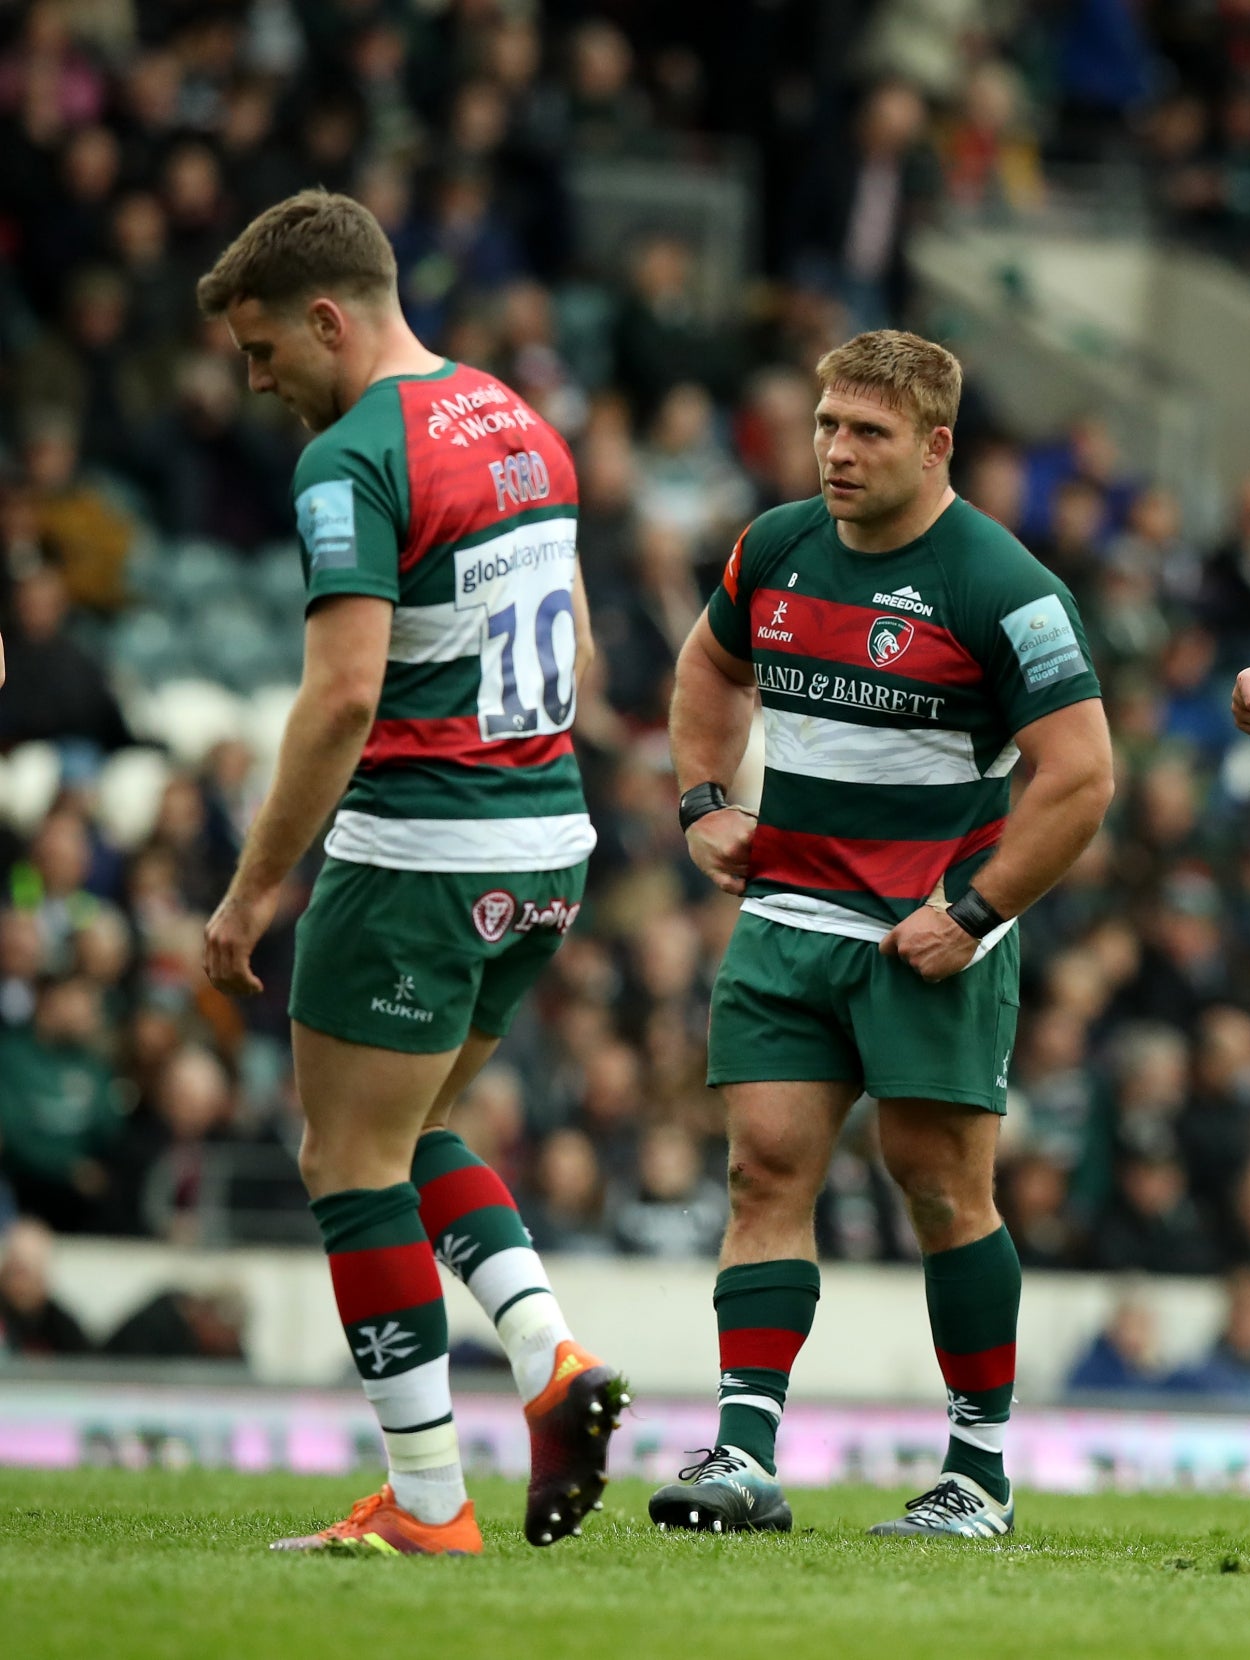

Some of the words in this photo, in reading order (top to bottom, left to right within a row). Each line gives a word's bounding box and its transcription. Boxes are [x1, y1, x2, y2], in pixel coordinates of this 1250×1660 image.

[488, 450, 550, 512] FORD
[787, 572, 799, 588] B
[872, 592, 934, 617] BREEDON
[757, 626, 794, 643] KUKRI
[1018, 625, 1071, 653] Gallagher
[488, 588, 576, 736] 10
[1029, 666, 1061, 685] RUGBY
[807, 672, 830, 700] &
[832, 676, 945, 720] BARRETT
[371, 997, 434, 1023] KUKRI
